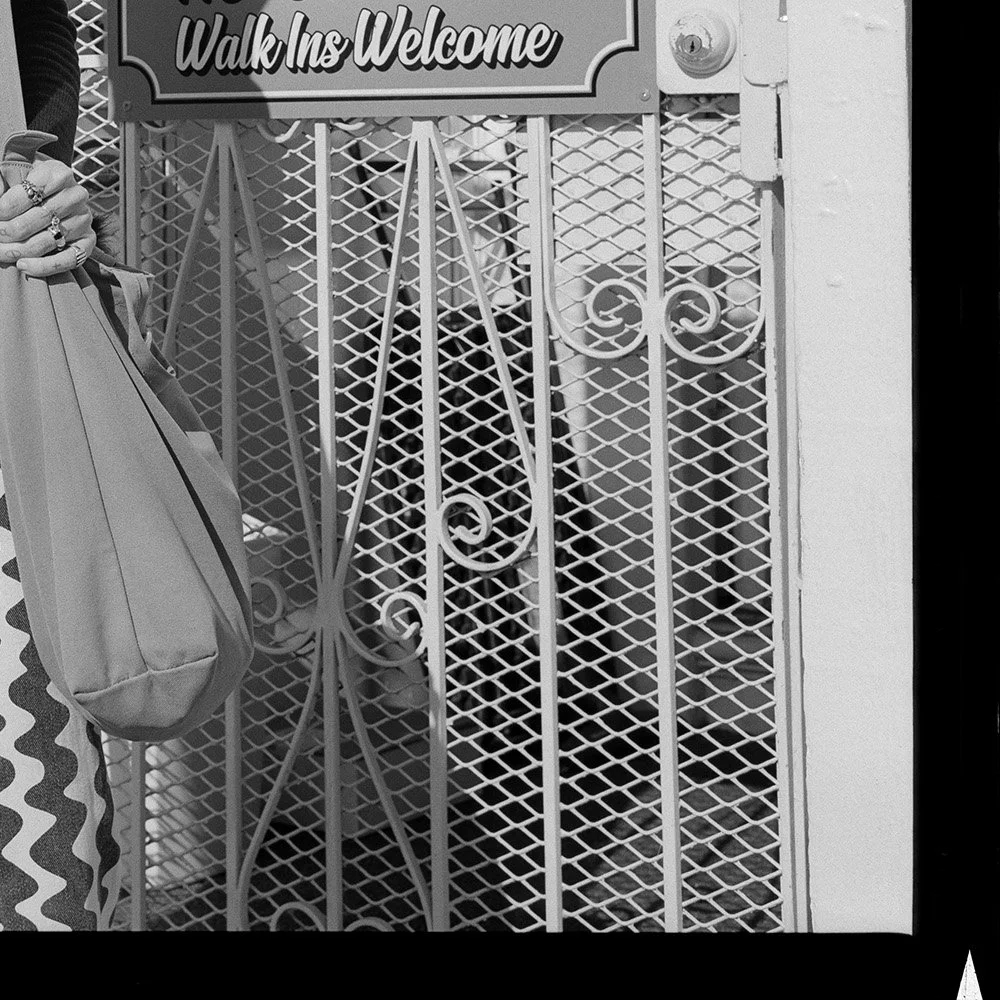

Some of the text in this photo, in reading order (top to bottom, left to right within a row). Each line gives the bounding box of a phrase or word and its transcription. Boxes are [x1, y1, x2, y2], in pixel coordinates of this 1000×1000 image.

[175, 4, 564, 77] Walk Ins Welcome
